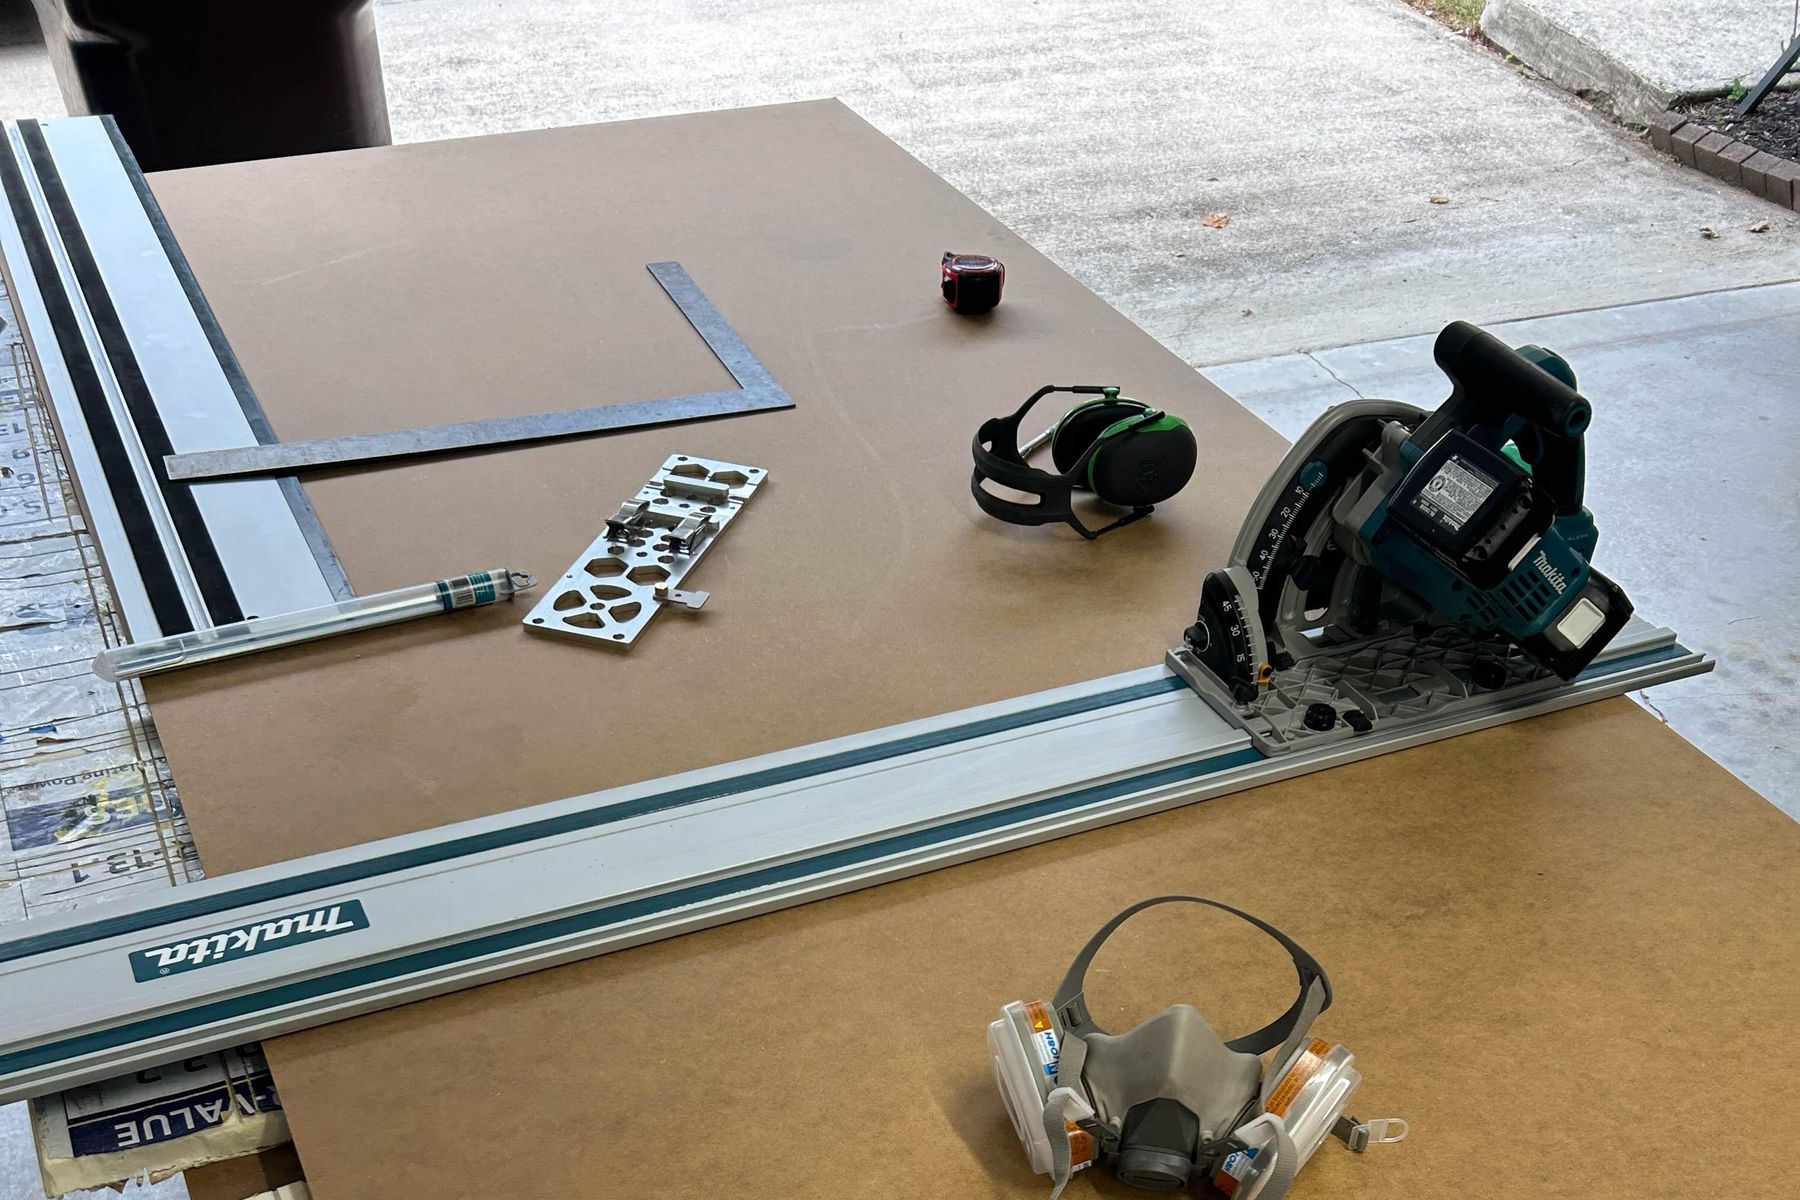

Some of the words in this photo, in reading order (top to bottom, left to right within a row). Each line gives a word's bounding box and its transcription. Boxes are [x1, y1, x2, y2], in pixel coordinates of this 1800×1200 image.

[1295, 485, 1304, 495] 10
[1280, 507, 1290, 518] 20
[1268, 528, 1278, 540] 30
[1259, 549, 1269, 561] 40
[1222, 600, 1232, 612] 45
[1230, 624, 1241, 637] 30
[1236, 653, 1246, 662] 15
